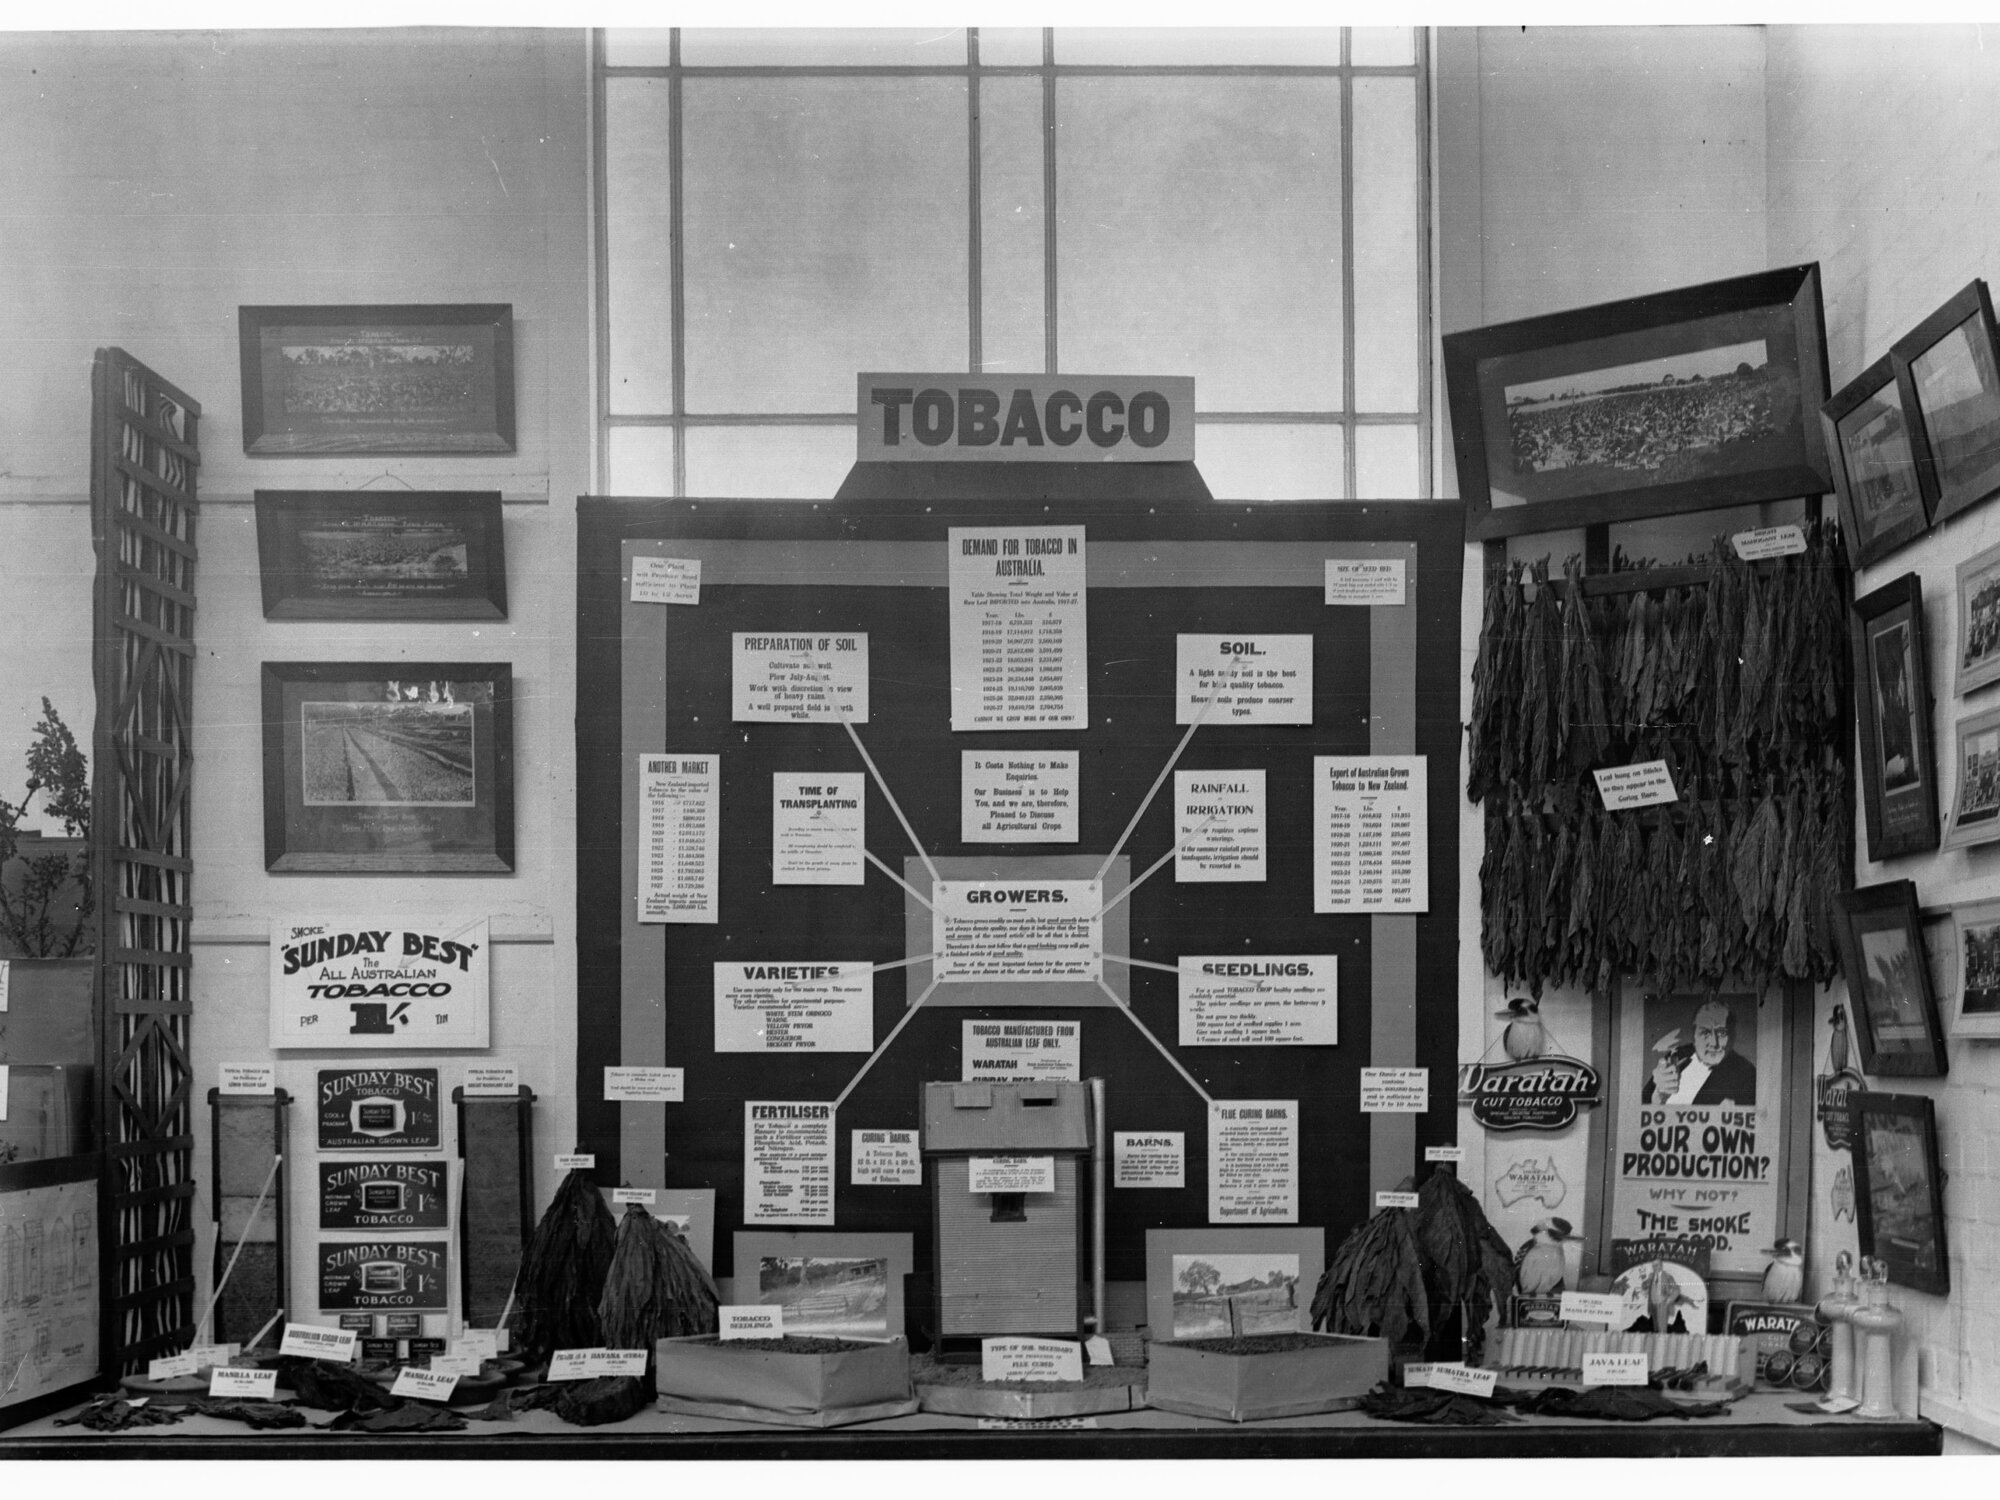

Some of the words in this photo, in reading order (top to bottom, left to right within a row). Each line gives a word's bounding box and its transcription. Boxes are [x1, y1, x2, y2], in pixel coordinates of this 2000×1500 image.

[872, 389, 1170, 448] TOBACCO
[962, 539, 998, 555] DEMAND
[1003, 539, 1019, 555] FOR
[1025, 538, 1062, 555] TOBACCO
[1068, 538, 1077, 554] IN
[996, 558, 1045, 576] AUSTRALIA.
[744, 637, 813, 651] PREPARATION
[818, 638, 830, 651] OF
[836, 638, 857, 651] SOIL
[1220, 642, 1267, 655] SOIL.
[1199, 669, 1214, 677] light
[1242, 669, 1253, 677] soil
[1257, 669, 1263, 677] is
[1267, 669, 1278, 677] the
[1282, 669, 1296, 677] best
[749, 684, 768, 692] Work
[1199, 680, 1209, 688] for
[1230, 681, 1254, 690] quality
[784, 693, 803, 701] heavy
[1217, 696, 1232, 704] soils
[1237, 697, 1263, 705] produce
[774, 704, 804, 712] prepared
[648, 761, 677, 773] ANOTHER
[682, 761, 709, 774] MARKET
[1008, 762, 1034, 770] Nothing
[1330, 767, 1349, 780] Export
[1350, 768, 1357, 777] of
[1358, 768, 1388, 777] Australian
[1390, 767, 1409, 777] Grown
[799, 786, 822, 795] TIME
[827, 786, 838, 795] OF
[1332, 781, 1355, 791] Tobacco
[1359, 781, 1365, 791] to
[1368, 781, 1380, 791] New
[1054, 788, 1069, 797] Help
[780, 800, 857, 808] TRANSPLANTING
[1187, 805, 1254, 815] IRRIGATION
[996, 823, 1037, 831] Agricultural
[967, 890, 1068, 903] GROWERS.
[291, 926, 325, 939] SMOKE
[281, 931, 392, 975] "SUNDAY
[403, 932, 479, 972] BEST"
[363, 957, 379, 968] The
[319, 967, 347, 980] ALL
[351, 967, 436, 979] AUSTRALIAN
[744, 966, 839, 980] VARIETIES
[1202, 963, 1314, 976] SEEDLINGS.
[307, 982, 451, 999] TOBACCO
[300, 1015, 319, 1027] PER
[435, 1014, 448, 1025] TIN
[973, 1025, 1001, 1035] TOBACCO
[1004, 1025, 1053, 1036] MANUFACTURED
[1057, 1026, 1074, 1036] FROM
[986, 1038, 1022, 1048] AUSTRALIAN
[1026, 1038, 1040, 1048] LEAF
[1043, 1038, 1061, 1048] ONLY.
[972, 1060, 1017, 1069] WARATAH
[1482, 1097, 1503, 1107] CUT
[1509, 1096, 1563, 1106] TOBACCO
[752, 1106, 829, 1119] FERTILISER
[1221, 1109, 1236, 1119] FLUE
[1240, 1109, 1262, 1119] CURING
[1641, 1111, 1666, 1128] DO
[1676, 1111, 1710, 1123] YOU
[1721, 1112, 1756, 1129] USE
[862, 1133, 885, 1143] CURING
[1641, 1125, 1690, 1153] OUR
[1702, 1126, 1755, 1154] OWN
[1623, 1153, 1770, 1179] PRODUCTION?
[327, 1164, 392, 1191] SUNDAY
[396, 1165, 440, 1188] BEST
[1650, 1188, 1687, 1200] WHY
[1695, 1190, 1738, 1202] NOT?
[354, 1215, 414, 1224] TOBACCO
[1637, 1209, 1678, 1231] THE
[1689, 1211, 1751, 1234] SMOKE
[326, 1244, 392, 1272] SUNDAY
[396, 1245, 441, 1269] BEST
[353, 1296, 413, 1304] TOBACCO
[1590, 1358, 1614, 1366] JAVA
[1618, 1358, 1644, 1366] LEAF
[404, 1371, 434, 1381] MANILLA
[1436, 1366, 1470, 1378] SUMATRA
